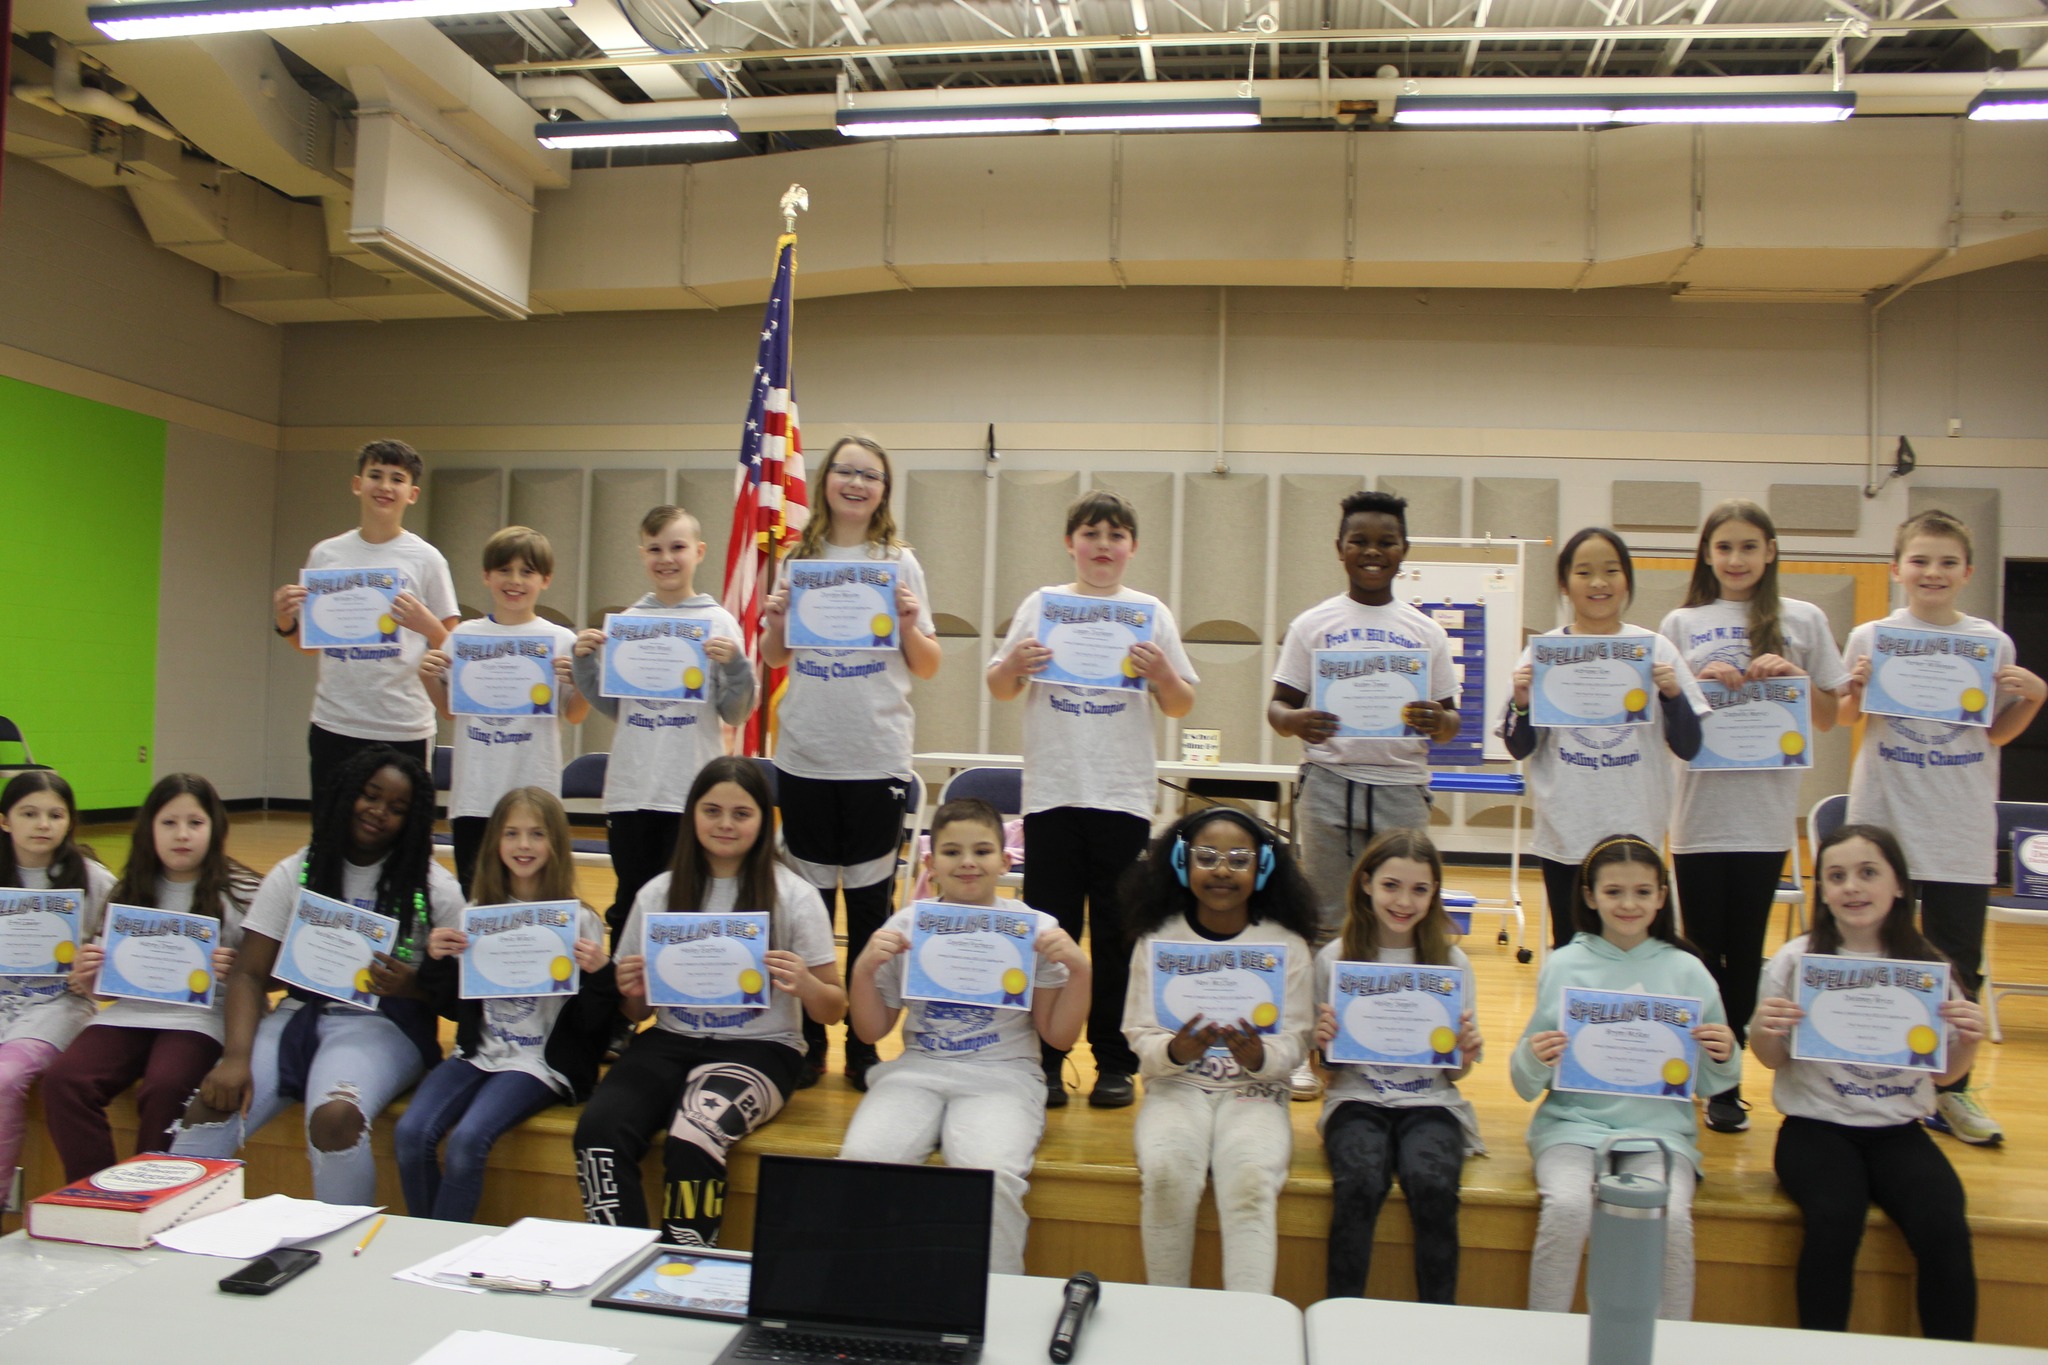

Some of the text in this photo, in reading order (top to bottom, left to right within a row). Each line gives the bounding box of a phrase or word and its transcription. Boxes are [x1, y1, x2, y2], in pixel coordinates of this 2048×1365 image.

[307, 572, 363, 595] SPELLING
[793, 566, 857, 589] SPELLING
[1043, 602, 1111, 624] SPELLING
[611, 621, 672, 640] SPELLING
[1325, 630, 1349, 649] Fred
[1365, 628, 1386, 643] Hill
[456, 640, 515, 661] SPELLING
[1535, 642, 1608, 665] SPELLING
[1877, 634, 1950, 656] SPELLING
[831, 659, 887, 679] Champion
[1319, 655, 1386, 680] SPELLING
[114, 914, 181, 937] SPELLING
[298, 900, 354, 931] SPELLING
[467, 910, 533, 935] SPELLING
[918, 911, 990, 935] SPELLING
[650, 920, 721, 944] SPELLING
[1157, 950, 1236, 975] SPELLING
[1339, 972, 1414, 996] SPELLING
[1805, 965, 1889, 991] SPELLING
[1569, 998, 1648, 1024] SPELLING
